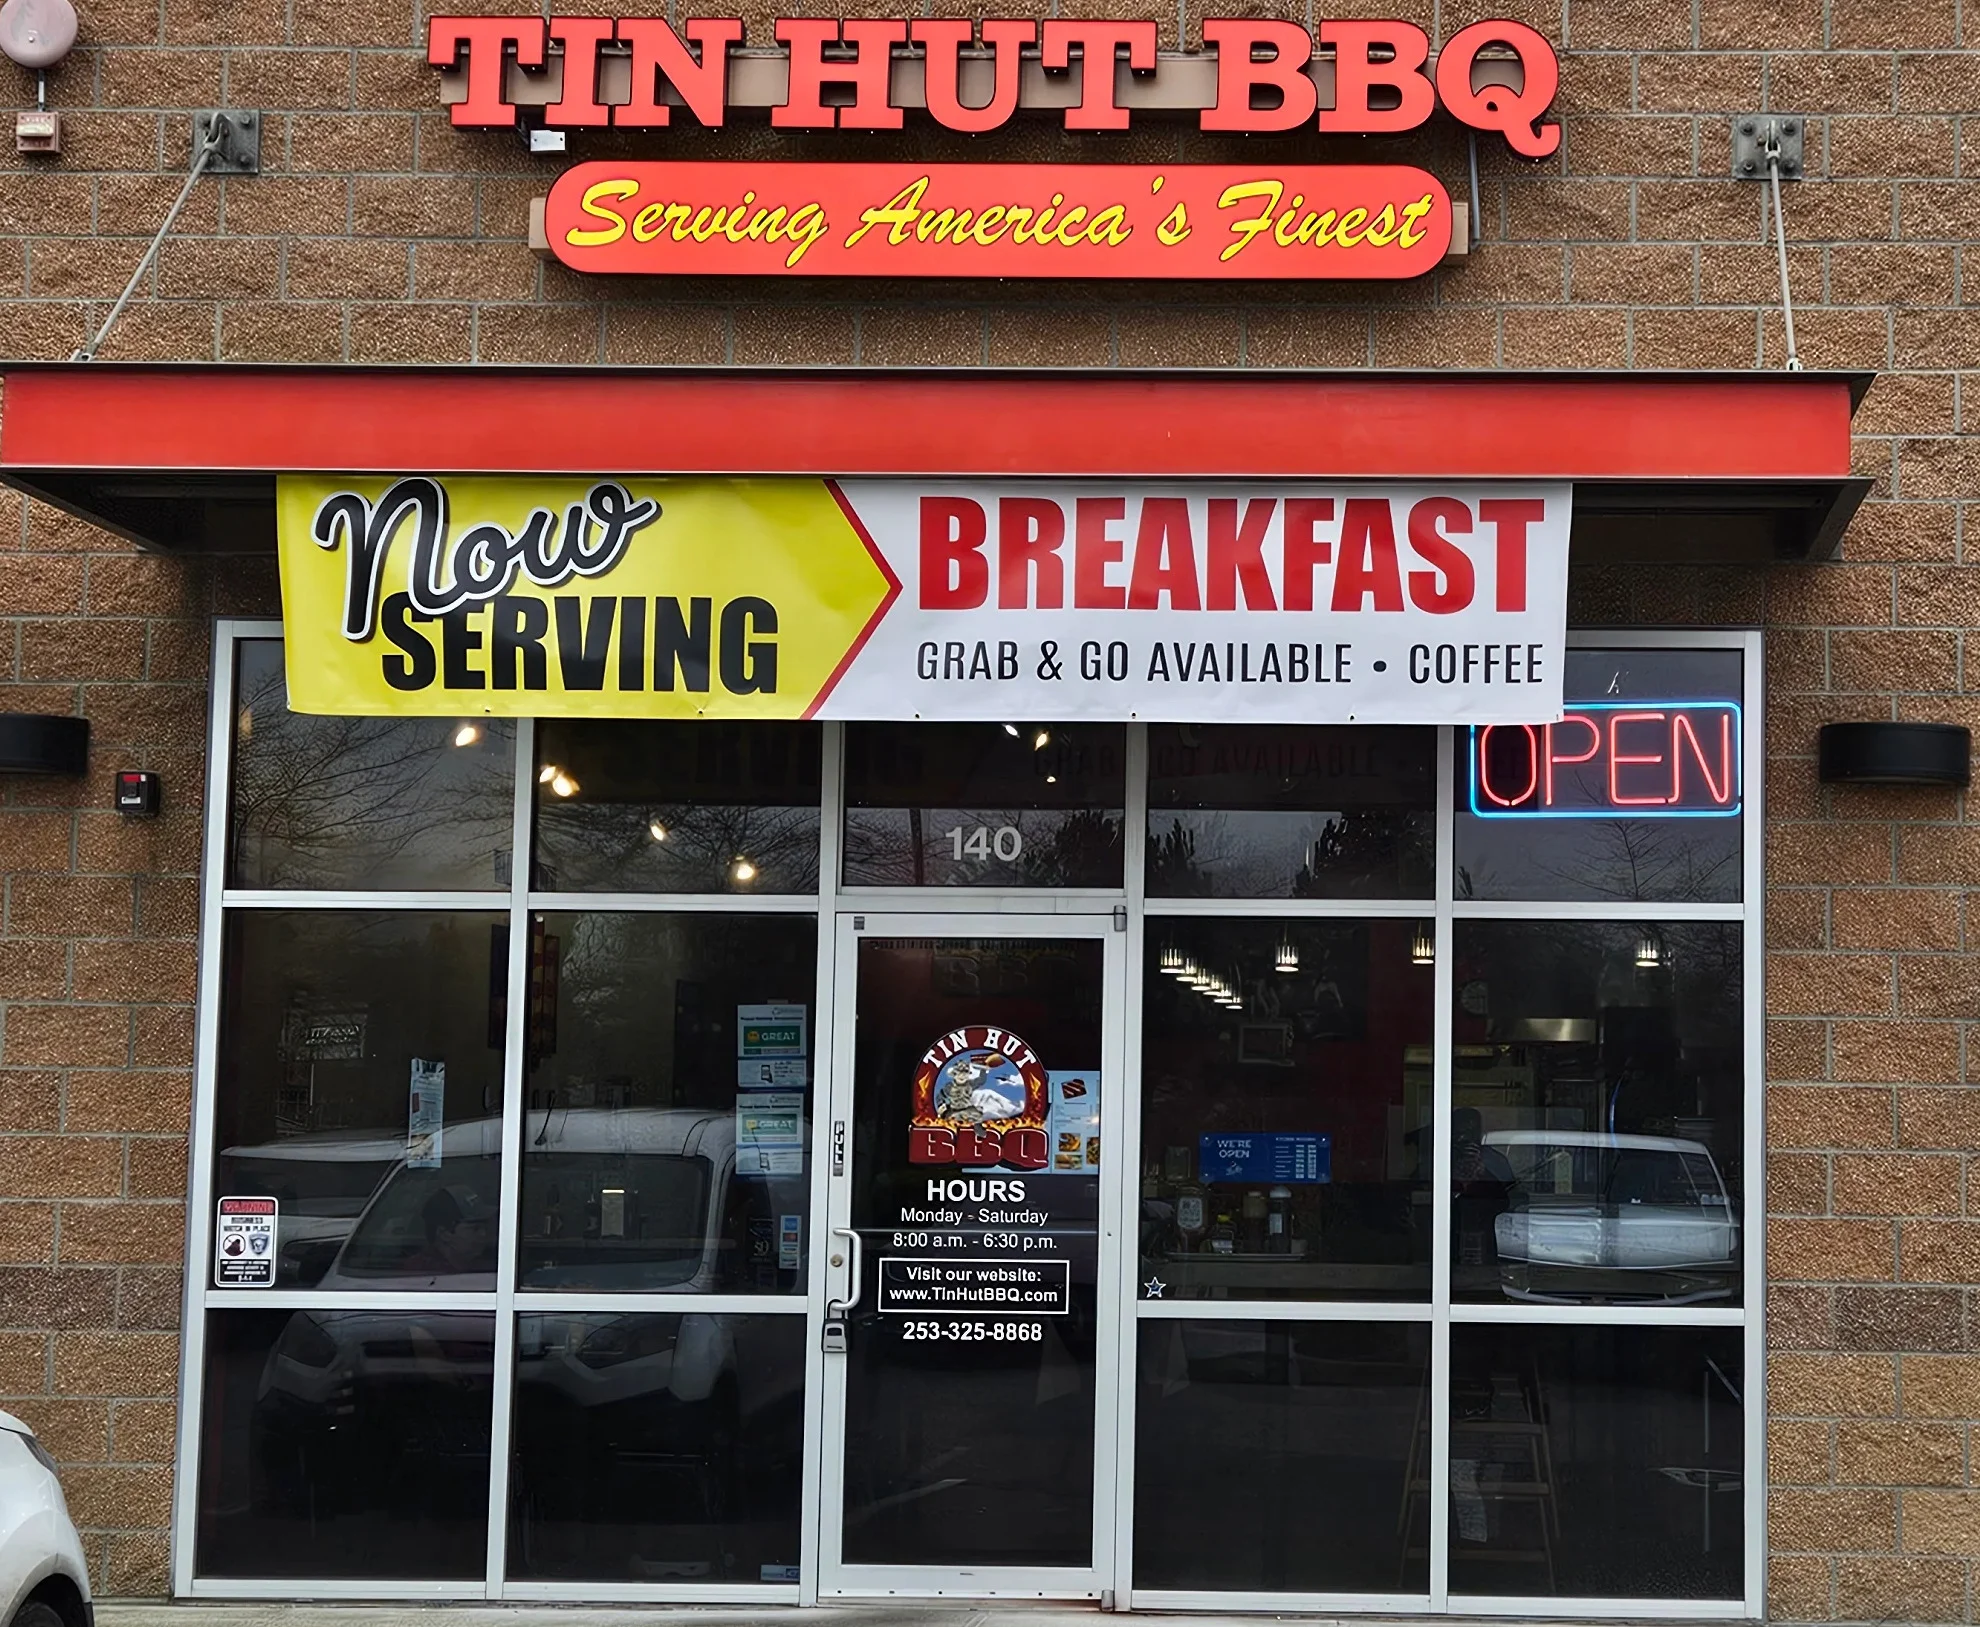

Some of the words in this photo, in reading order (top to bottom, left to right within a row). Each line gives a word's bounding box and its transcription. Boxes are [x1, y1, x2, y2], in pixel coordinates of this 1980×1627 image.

[428, 16, 744, 128] TIN
[771, 18, 1157, 132] HUT
[1200, 19, 1561, 157] BBQ
[566, 178, 829, 268] Serving
[845, 176, 1191, 248] America's
[1218, 180, 1434, 262] Finest
[311, 477, 660, 640] Now
[919, 497, 1545, 614] BREAKFAST
[381, 592, 778, 695] SERVING
[917, 641, 1019, 681] GRAB
[1036, 641, 1063, 681] &
[1080, 641, 1129, 682] GO
[1147, 642, 1352, 683] AVAILABLE
[1409, 643, 1543, 684] COFFEE
[1480, 714, 1729, 806] OPEN
[945, 826, 1022, 862] 140
[761, 1031, 796, 1041] GREAT
[923, 1030, 968, 1068] TIN
[984, 1029, 1036, 1068] HUT
[909, 1126, 1049, 1169] BBQ
[1219, 1149, 1250, 1158] OPEN
[927, 1179, 1026, 1203] HOURS
[901, 1207, 964, 1225] Monday
[979, 1207, 1049, 1226] Saturday
[892, 1233, 929, 1248] 8:00
[932, 1236, 968, 1248] a.m.
[983, 1233, 1019, 1249] 6:30
[1023, 1237, 1058, 1252] p.m.
[906, 1266, 941, 1281] Visit
[945, 1270, 973, 1281] our
[976, 1267, 1041, 1282] website:
[889, 1286, 1058, 1303] www.TinHutBBQ.com
[902, 1321, 1043, 1342] 253-325-8868
